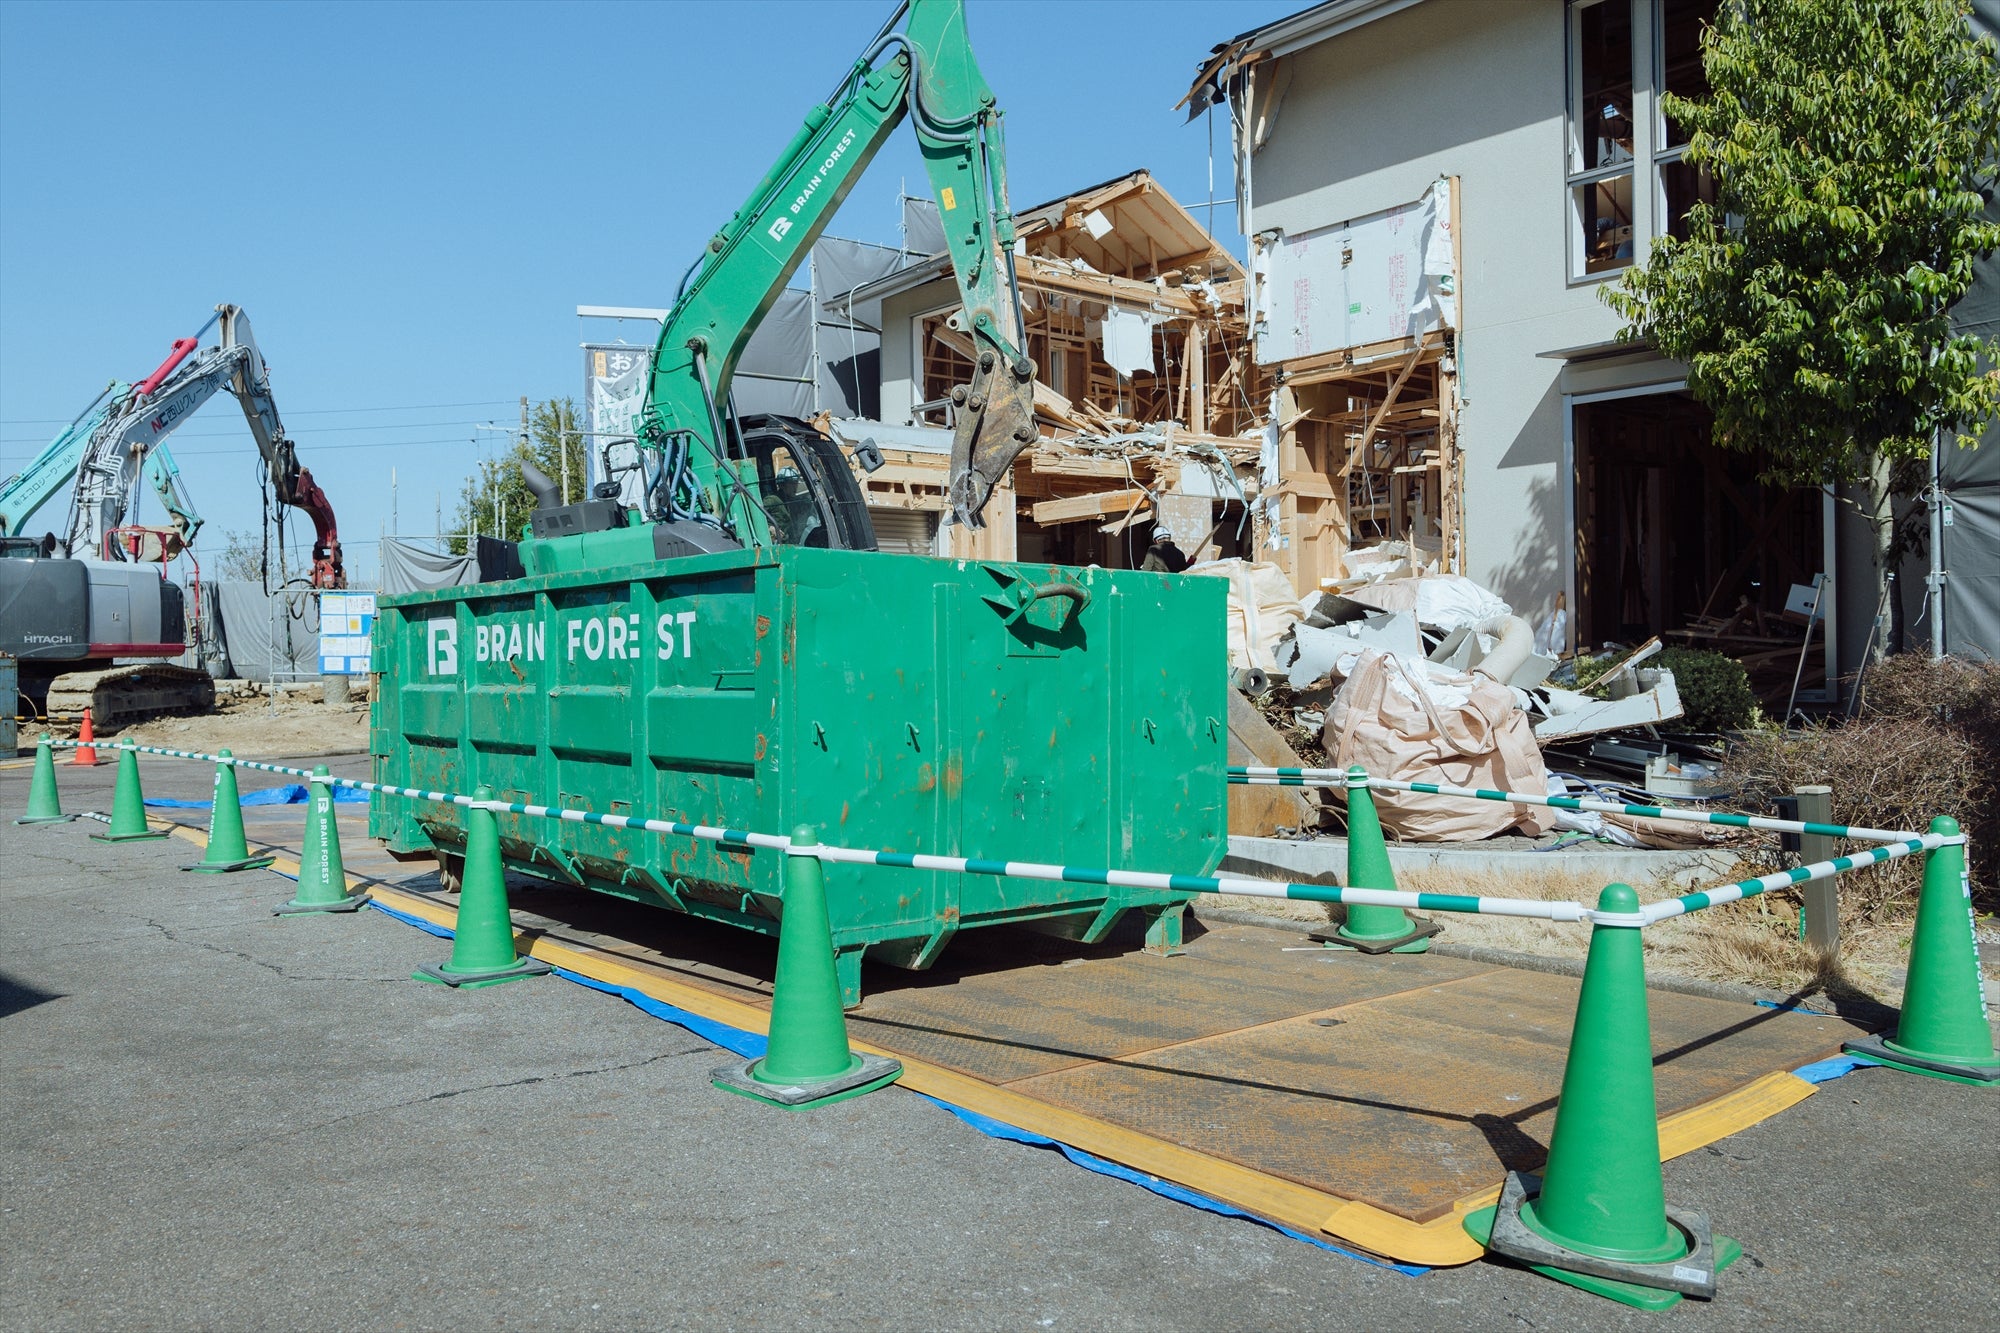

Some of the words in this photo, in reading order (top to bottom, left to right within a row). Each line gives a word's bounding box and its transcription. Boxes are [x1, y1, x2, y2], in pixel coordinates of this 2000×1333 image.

[790, 175, 822, 214] BRAIN
[819, 128, 856, 176] FOREST
[24, 635, 72, 643] HITACHI
[476, 621, 545, 662] BRAIN
[567, 611, 696, 660] FOREST
[320, 818, 328, 847] BRAIN
[321, 849, 329, 884] FOREST
